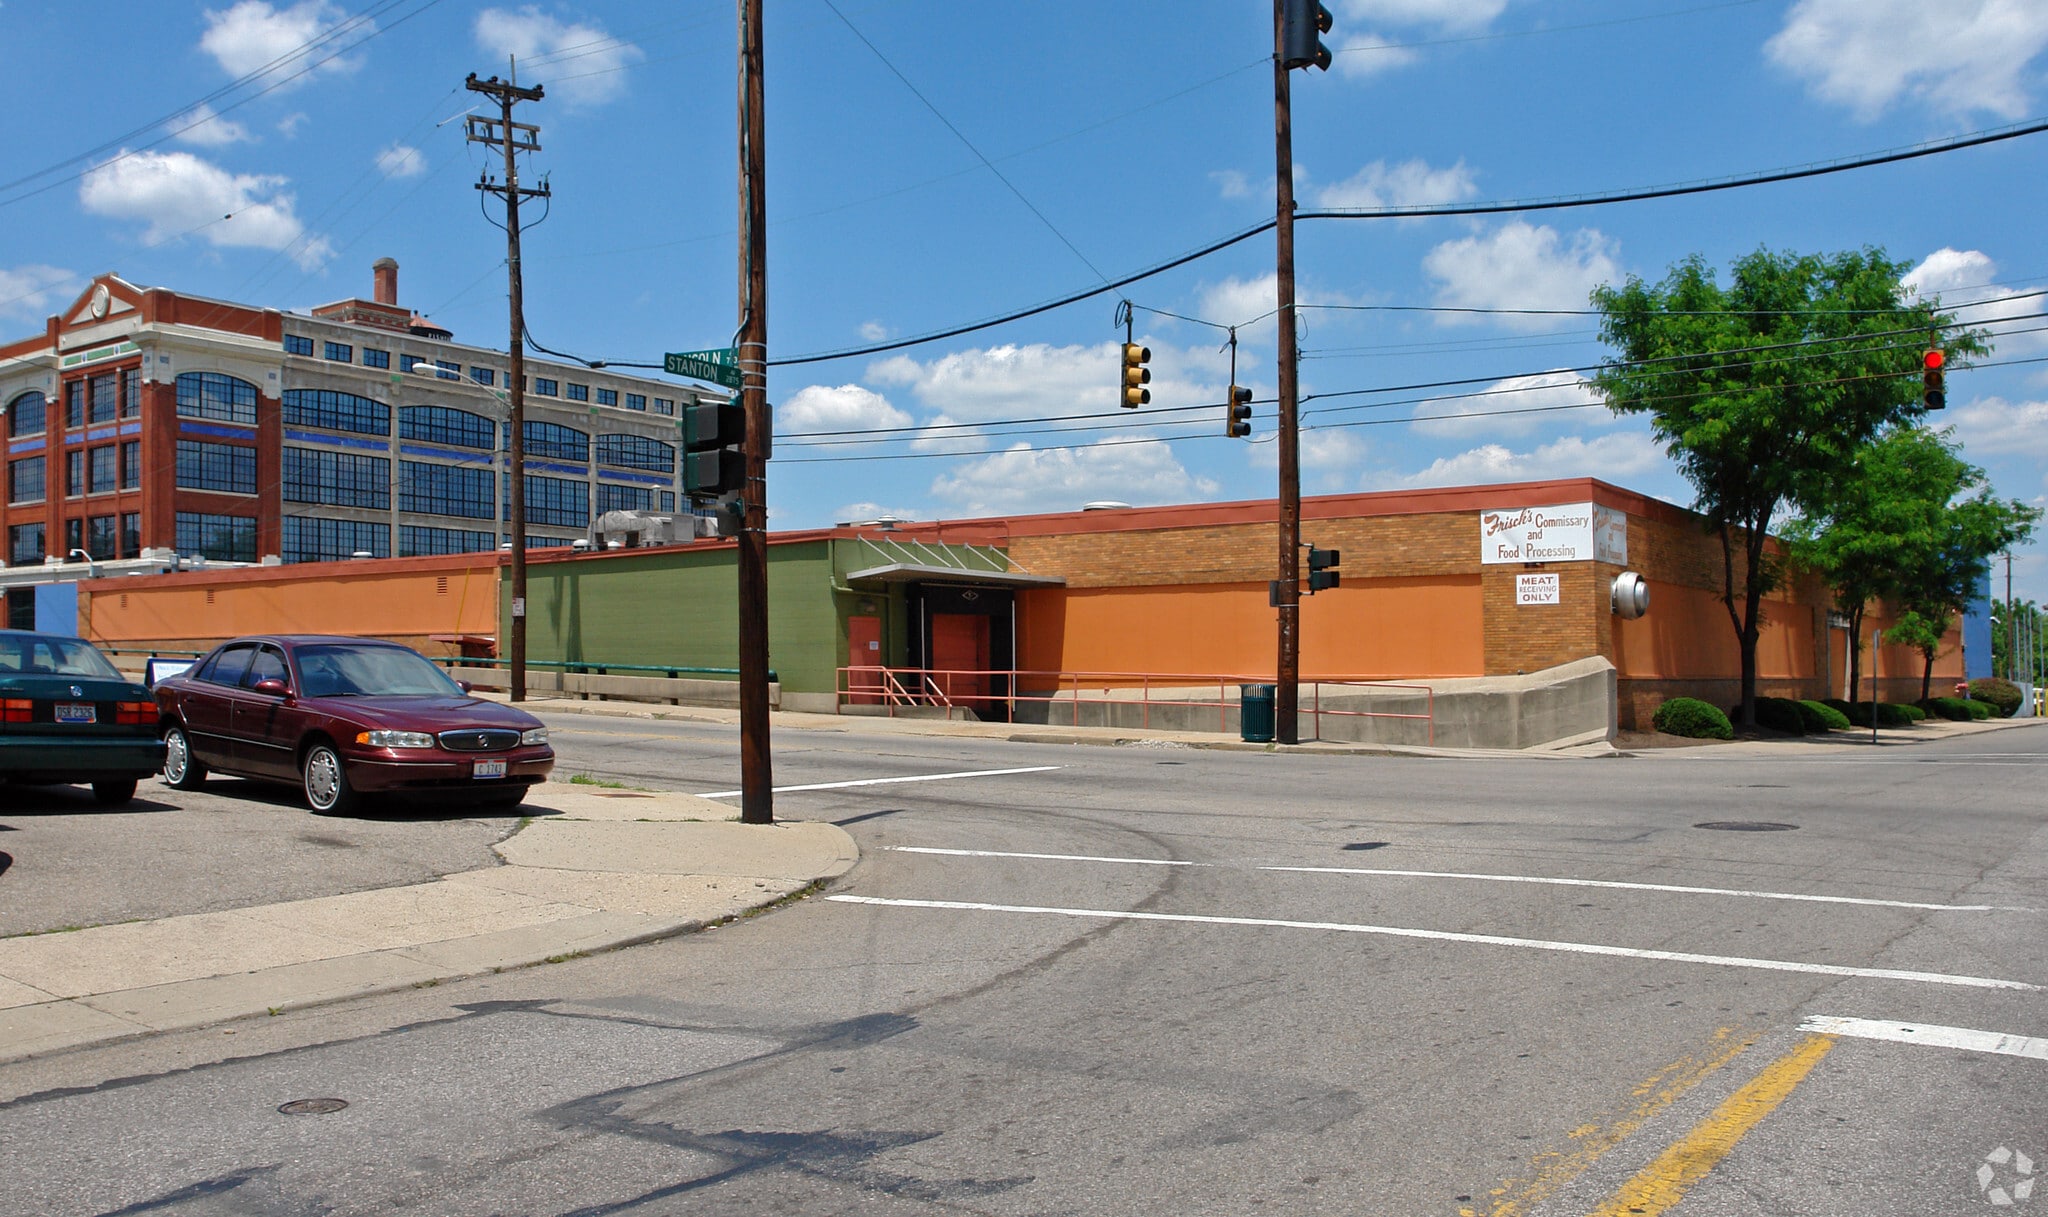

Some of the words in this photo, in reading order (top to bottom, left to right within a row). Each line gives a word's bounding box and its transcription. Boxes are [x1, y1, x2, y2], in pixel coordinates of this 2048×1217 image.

[667, 356, 718, 381] STANTON
[1483, 508, 1532, 536] Frisch's
[1535, 513, 1589, 528] Commissary
[1527, 528, 1542, 540] and
[1498, 544, 1520, 559] Food
[1526, 543, 1576, 559] Processing
[1521, 576, 1554, 585] MEAT
[1519, 585, 1557, 593] RECEIVING
[1522, 593, 1553, 602] ONLY
